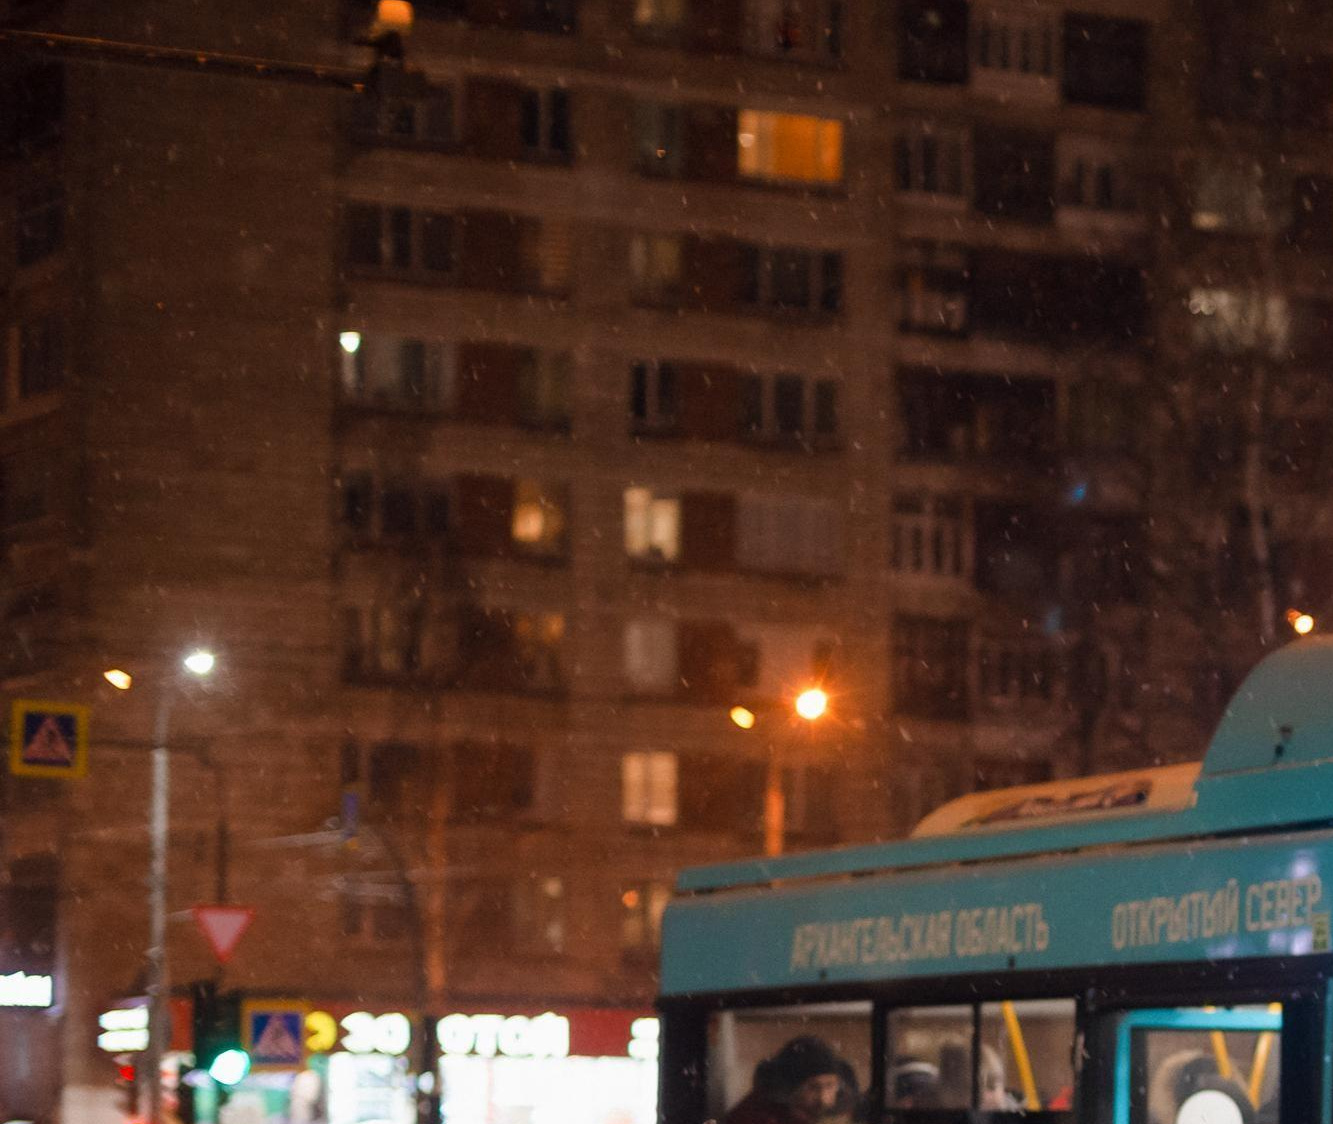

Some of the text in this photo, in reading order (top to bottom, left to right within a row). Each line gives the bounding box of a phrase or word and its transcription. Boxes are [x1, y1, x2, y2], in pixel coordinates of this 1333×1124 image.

[790, 902, 1049, 972] АРХАНГЕЛЬСКАЯ ОБЛАСТЬ
[1112, 878, 1239, 950] ОТКРЫТЫЙ
[1245, 874, 1323, 932] СЕВЕР
